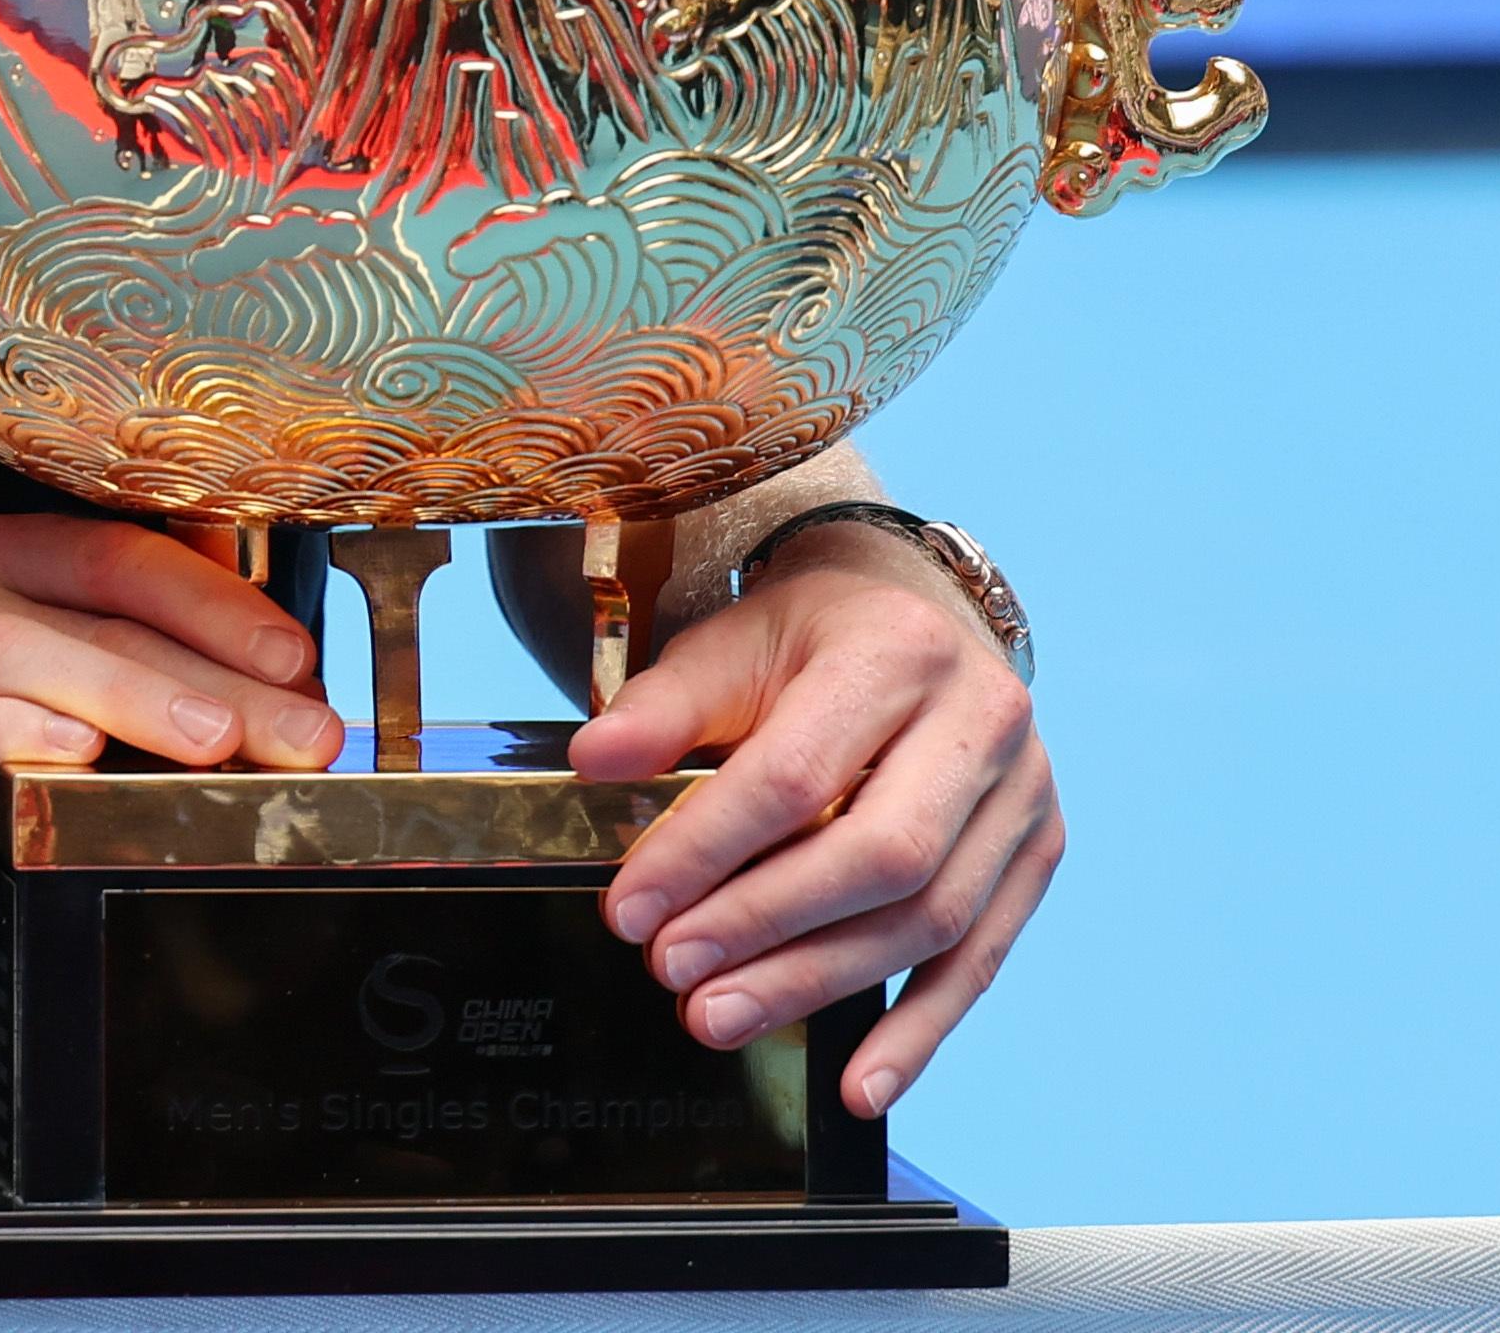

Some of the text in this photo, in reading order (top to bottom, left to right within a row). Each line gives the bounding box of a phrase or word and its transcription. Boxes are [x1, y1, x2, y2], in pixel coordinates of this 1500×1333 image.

[461, 998, 555, 1020] CHINA
[455, 1021, 544, 1043] OPEN
[166, 1094, 301, 1131] Men's
[319, 1088, 489, 1138] Singles
